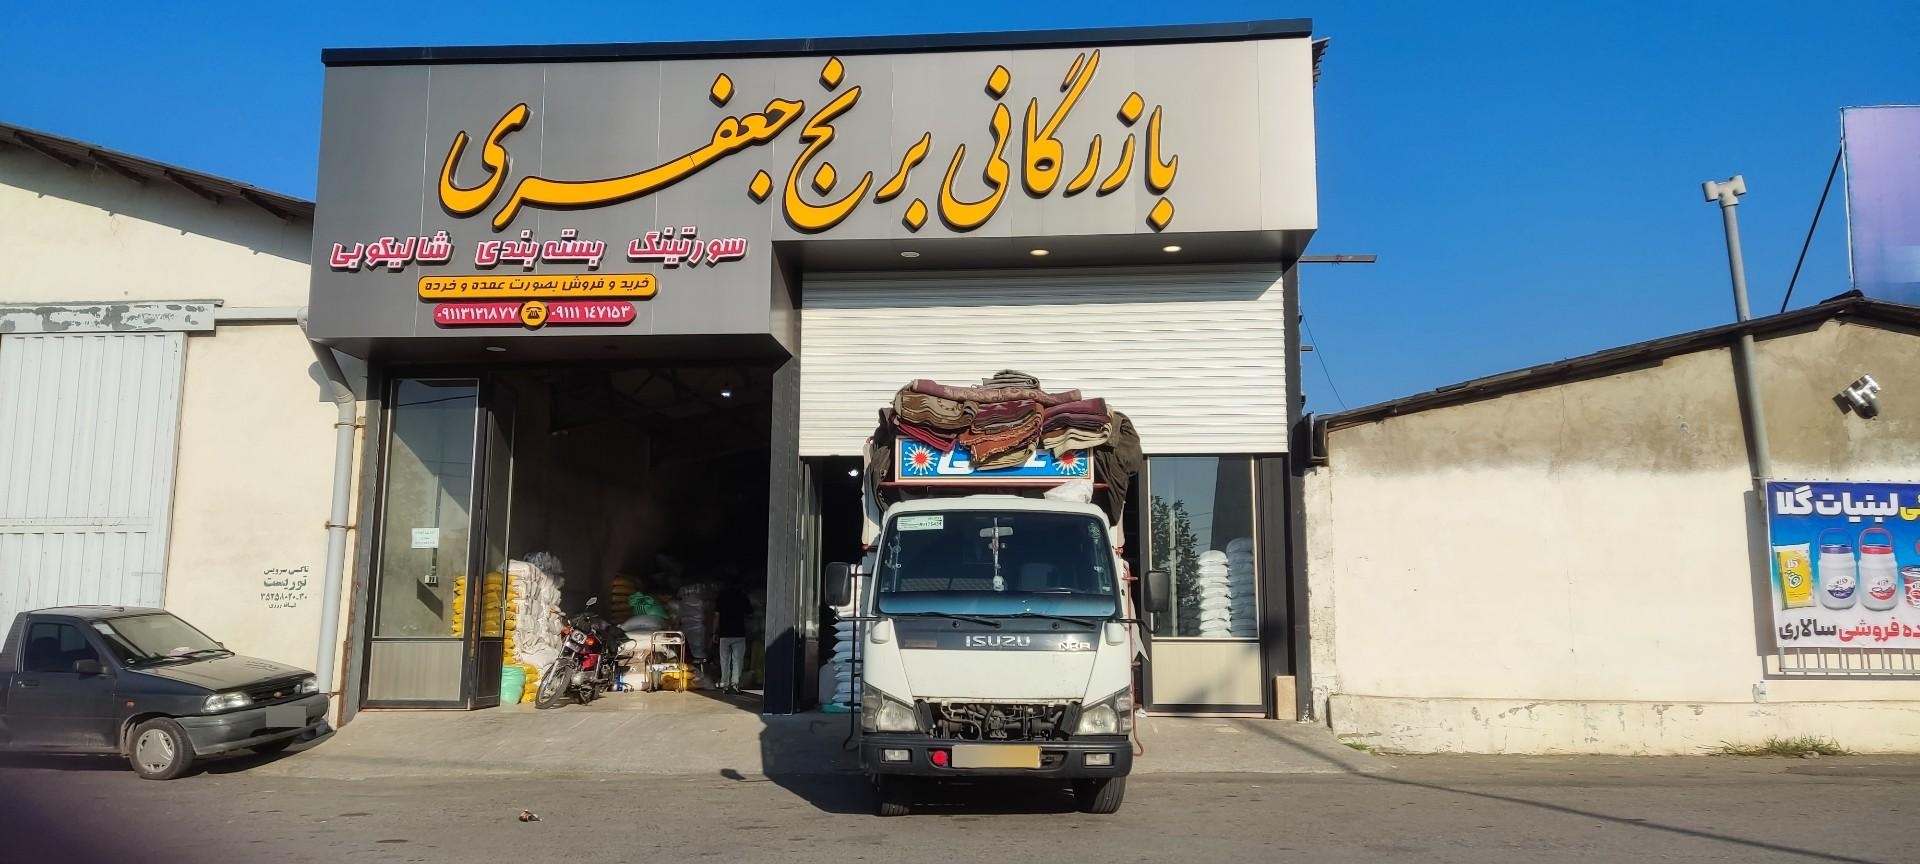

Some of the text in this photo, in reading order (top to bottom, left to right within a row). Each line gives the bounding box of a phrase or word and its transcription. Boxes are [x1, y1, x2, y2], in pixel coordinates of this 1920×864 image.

[438, 48, 1179, 233] بازرگانی برنج جعفری
[329, 230, 453, 270] شالیکوبی
[627, 225, 748, 268] سورتینگ
[424, 275, 650, 293] خرید و فروش بصورت عمده و خرده
[1775, 484, 1814, 516] گلا
[1815, 491, 1899, 523] لبنیات
[263, 565, 310, 576] تاکسی سرویس
[263, 575, 308, 591] توریست
[965, 635, 1031, 647] ISUZU
[1778, 618, 1837, 641] سالاری
[1839, 616, 1900, 642] فروشی
